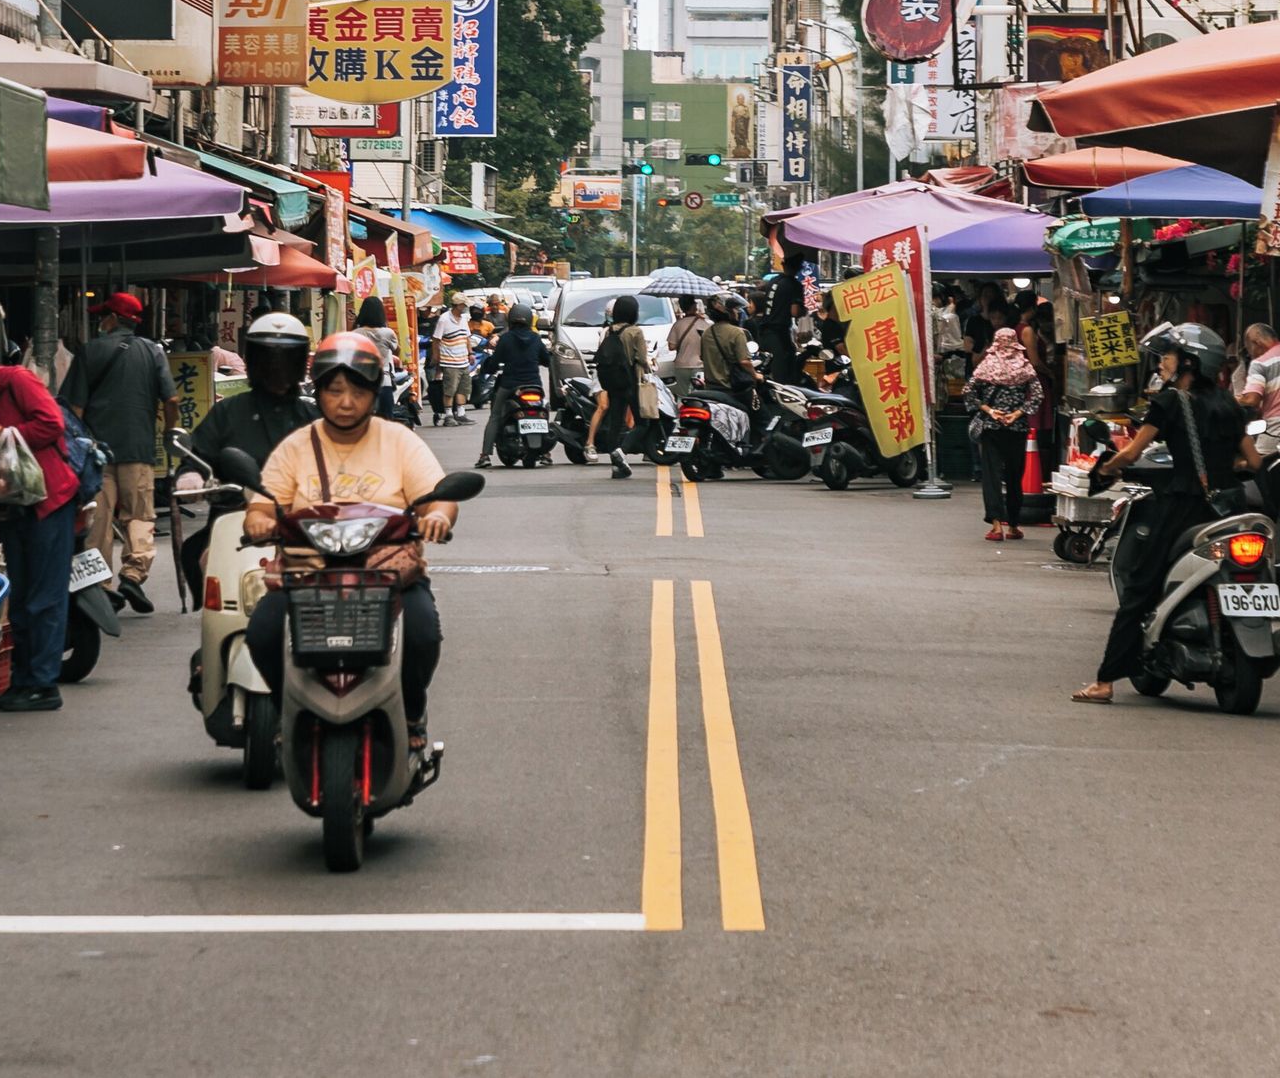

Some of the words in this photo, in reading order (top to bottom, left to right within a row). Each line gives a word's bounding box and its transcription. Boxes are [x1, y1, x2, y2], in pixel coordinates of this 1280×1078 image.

[309, 6, 445, 44] 黃金買賣
[224, 33, 300, 56] 美容美髮
[309, 45, 445, 84] 收購K金
[449, 16, 482, 131] 招牌鴨肉飯
[1085, 328, 1102, 359] 花生
[1098, 324, 1123, 356] 玉米
[863, 317, 916, 443] 廣東粥
[1223, 594, 1280, 611] 196-GXU
